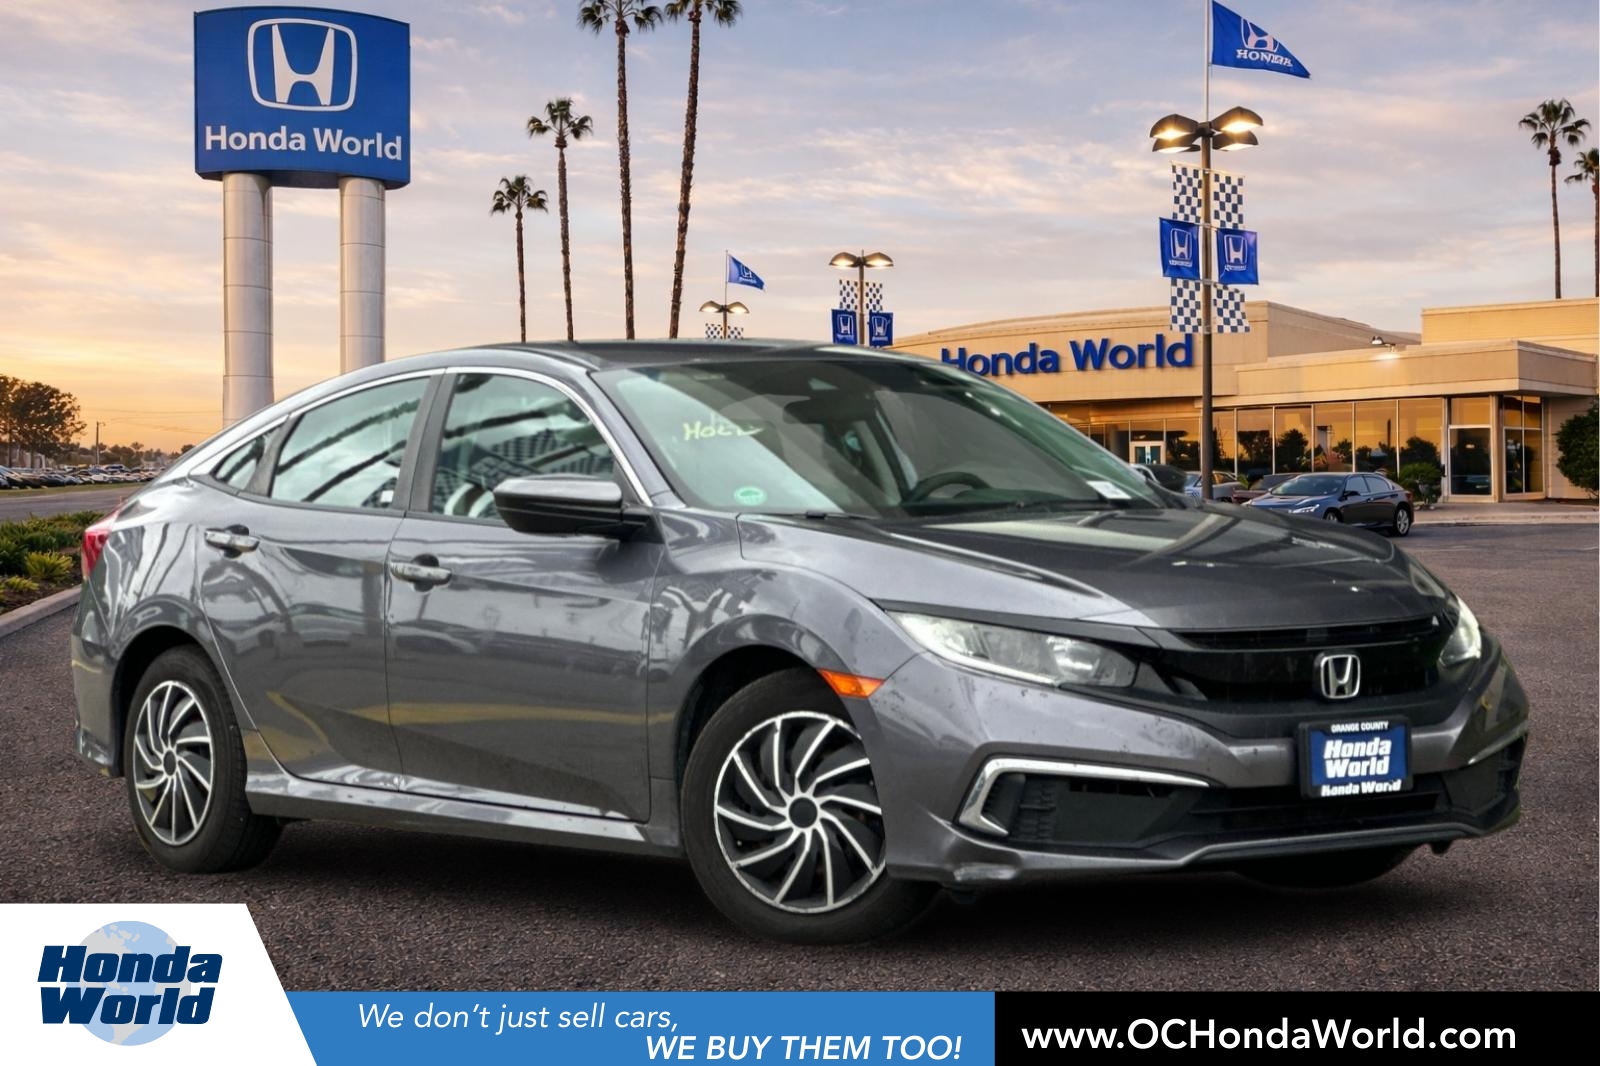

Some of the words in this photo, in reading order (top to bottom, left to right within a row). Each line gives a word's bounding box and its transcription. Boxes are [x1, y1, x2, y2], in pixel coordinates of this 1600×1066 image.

[205, 125, 306, 151] Honda
[313, 127, 402, 161] World
[941, 343, 1060, 377] Honda
[1069, 333, 1194, 371] World
[1361, 720, 1389, 731] COUNTY
[1323, 737, 1392, 759] Honda
[1325, 756, 1390, 778] World
[1321, 783, 1360, 797] Honda
